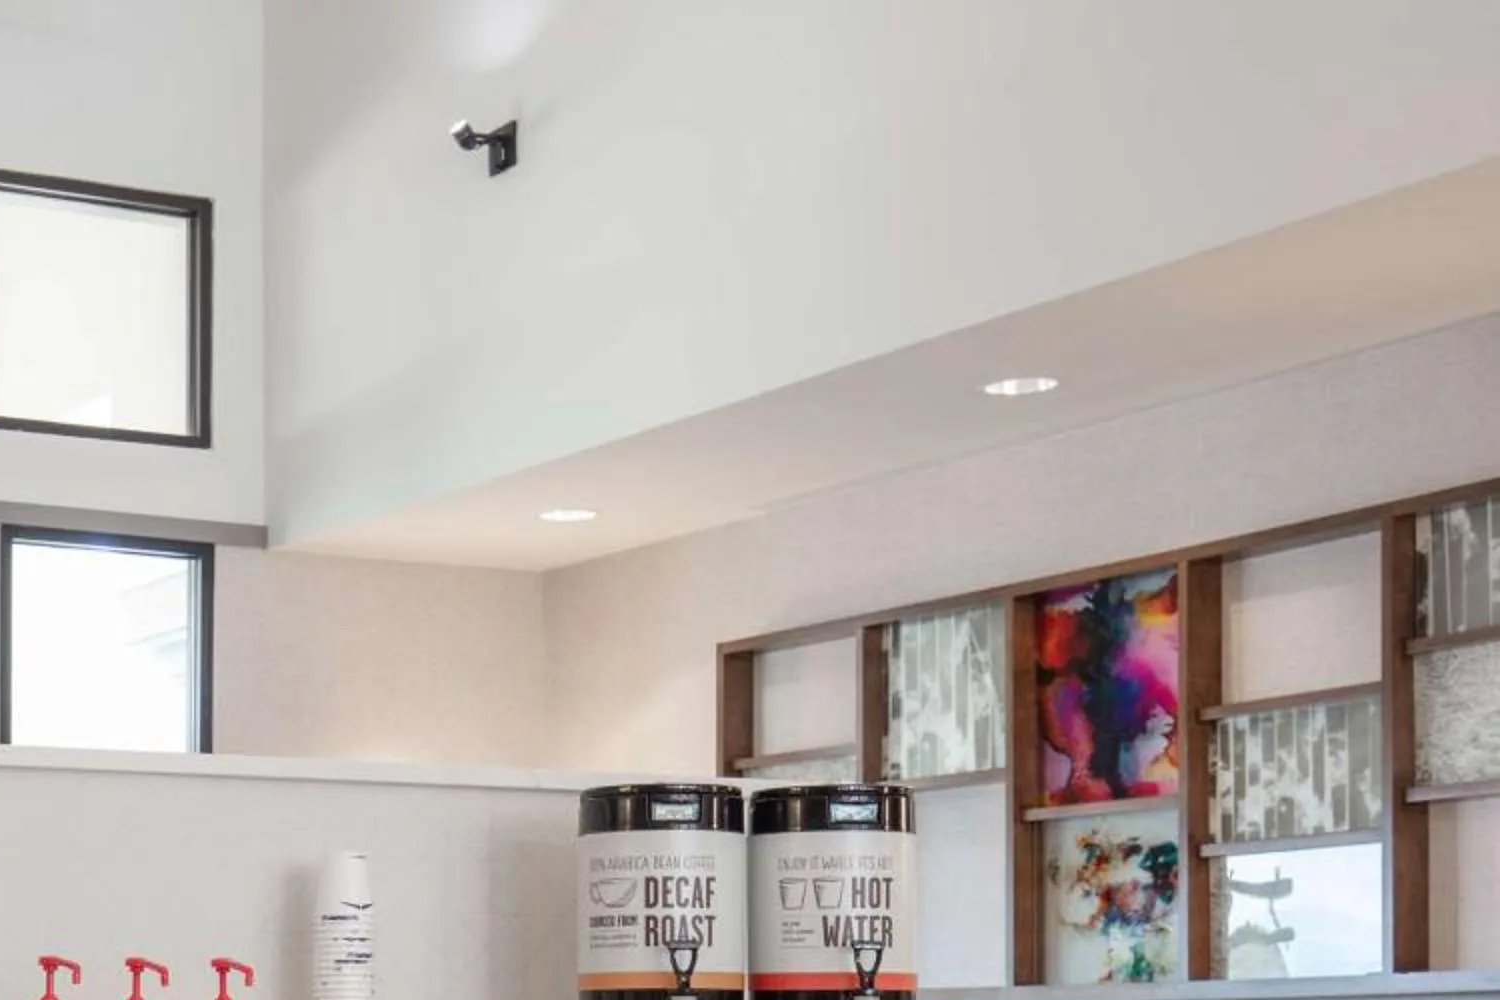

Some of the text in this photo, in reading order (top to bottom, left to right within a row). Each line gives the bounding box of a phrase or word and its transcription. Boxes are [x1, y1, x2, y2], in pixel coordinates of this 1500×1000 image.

[644, 876, 716, 909] DECAF
[852, 877, 894, 909] HOT
[645, 915, 716, 947] ROAST
[822, 915, 893, 948] WATER
